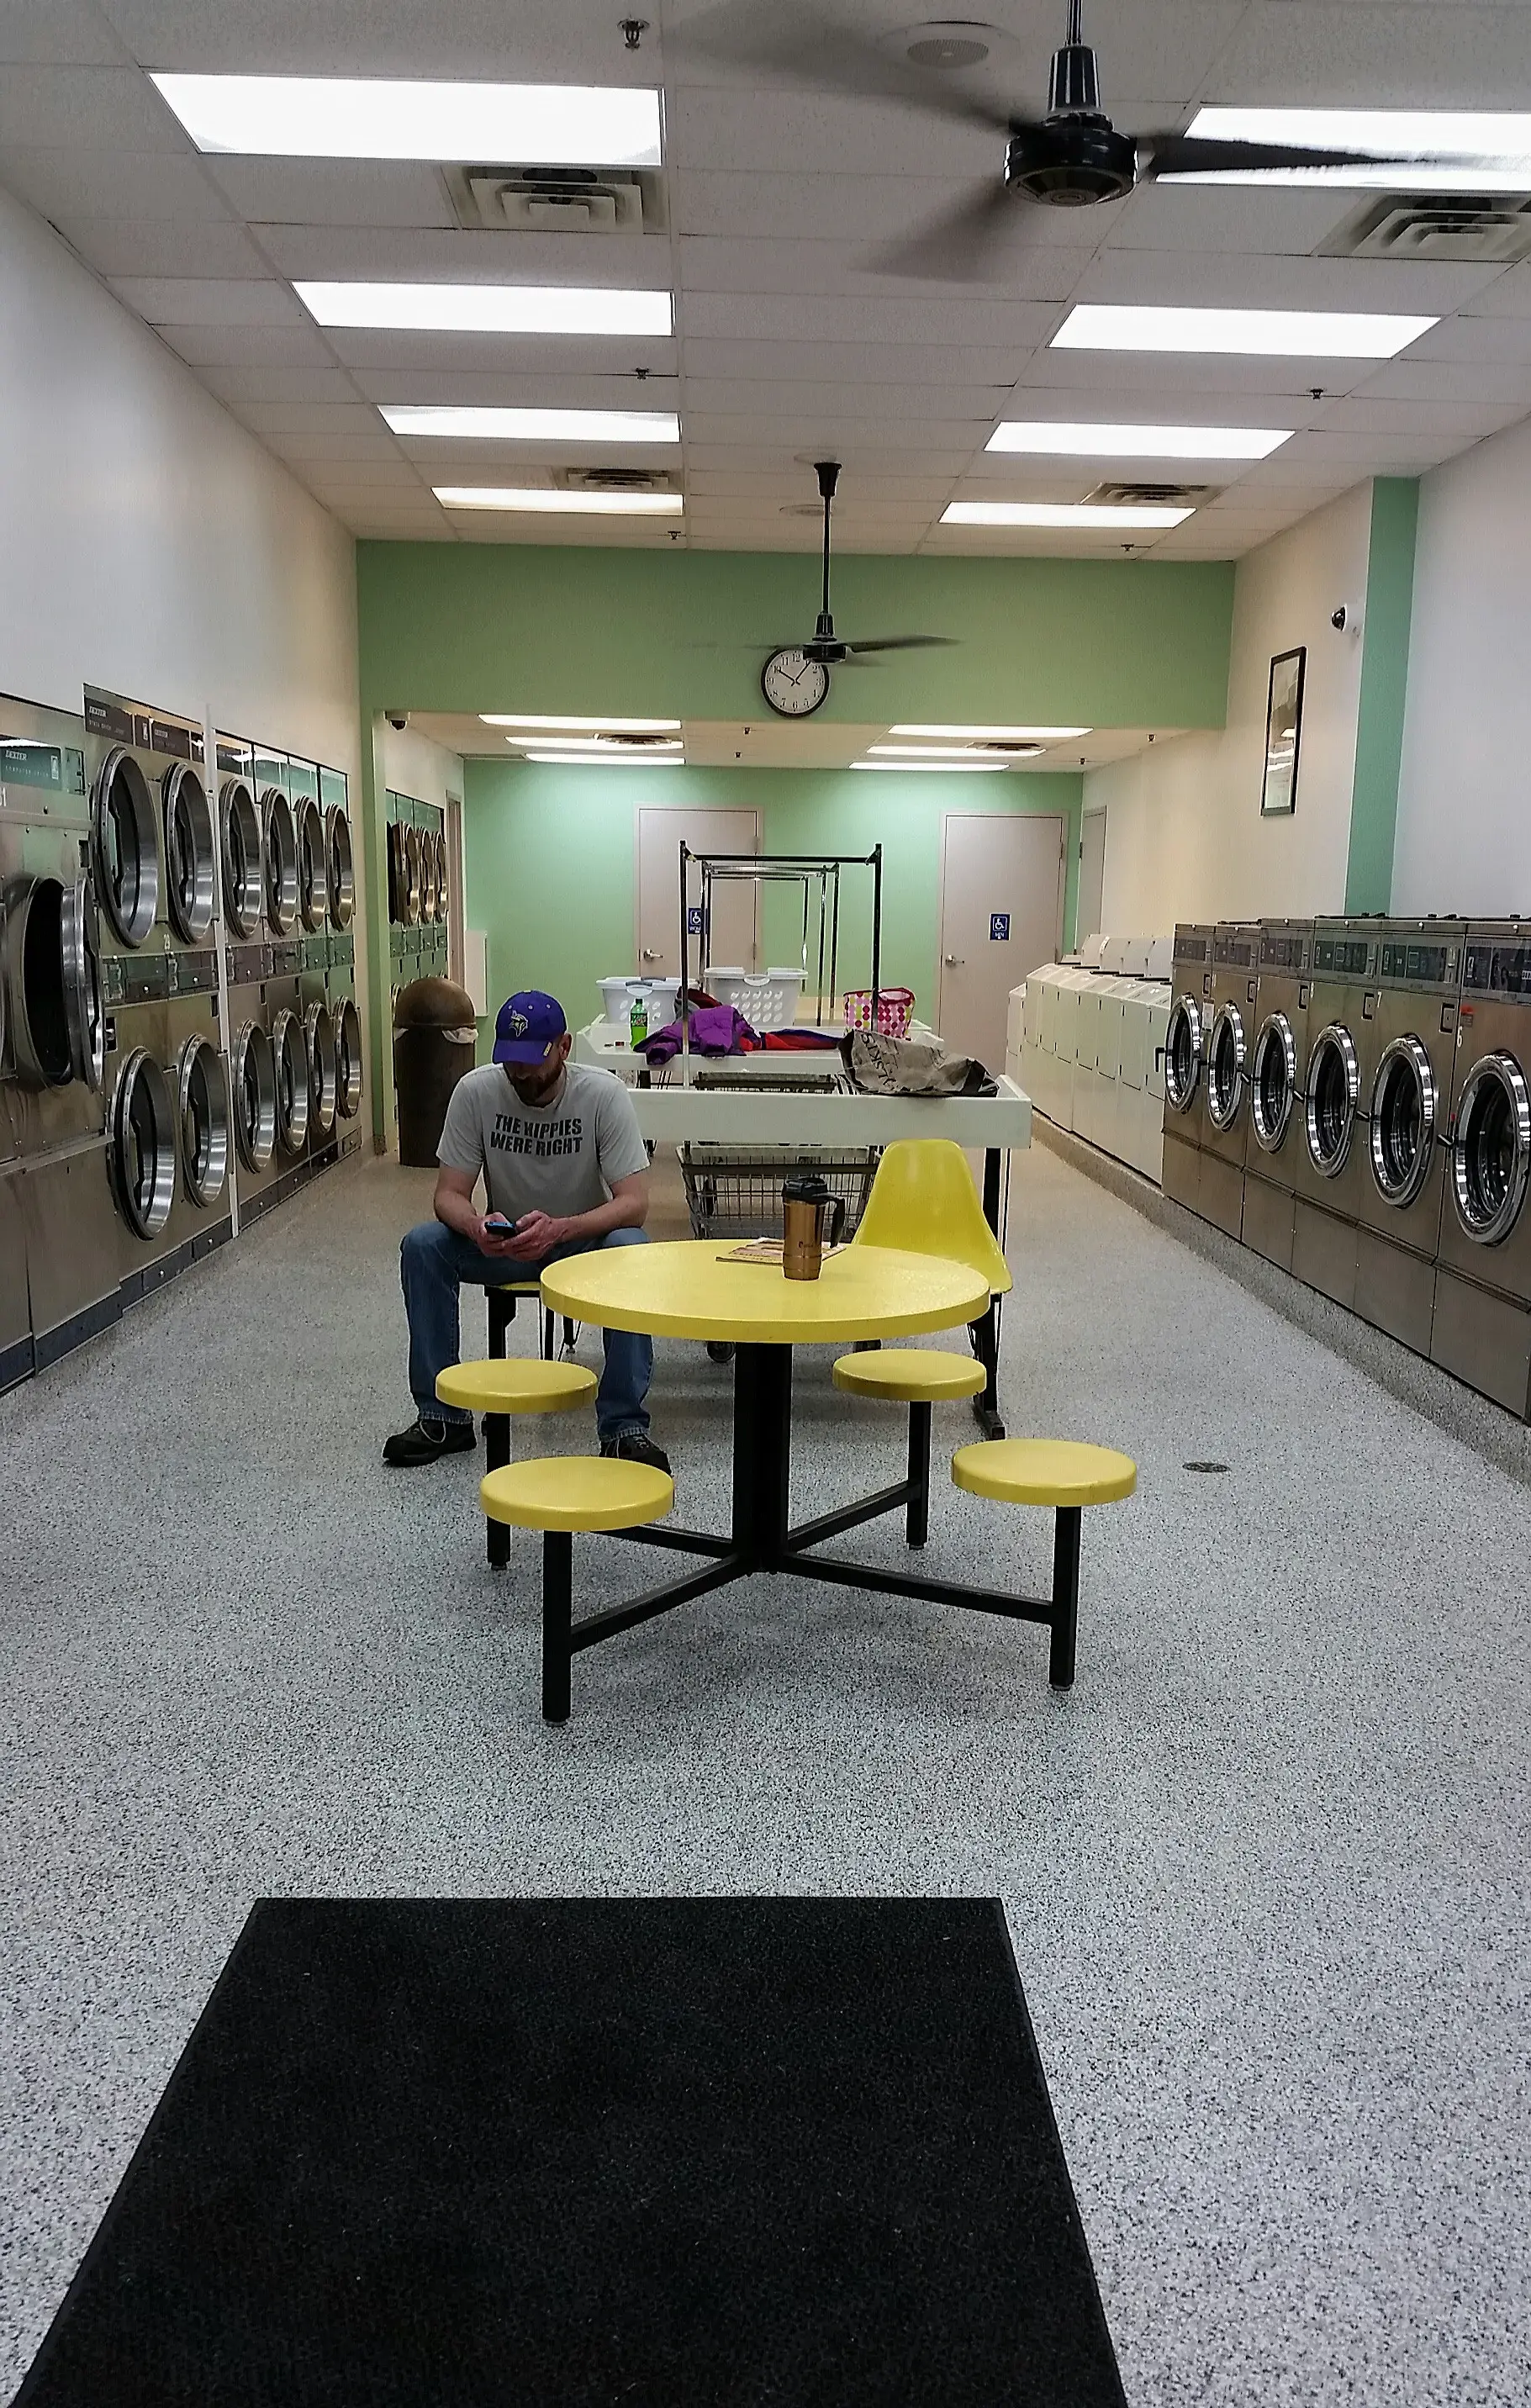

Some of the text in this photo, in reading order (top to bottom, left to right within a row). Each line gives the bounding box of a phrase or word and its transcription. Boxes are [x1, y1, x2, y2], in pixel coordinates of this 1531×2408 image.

[782, 657, 789, 665] 11
[793, 653, 800, 662] 12
[812, 665, 818, 673] 2
[1377, 991, 1382, 1008] 7
[1456, 1026, 1463, 1048] 6
[495, 1113, 582, 1139] THE HIPPIES
[490, 1131, 583, 1157] WERE RIGHT
